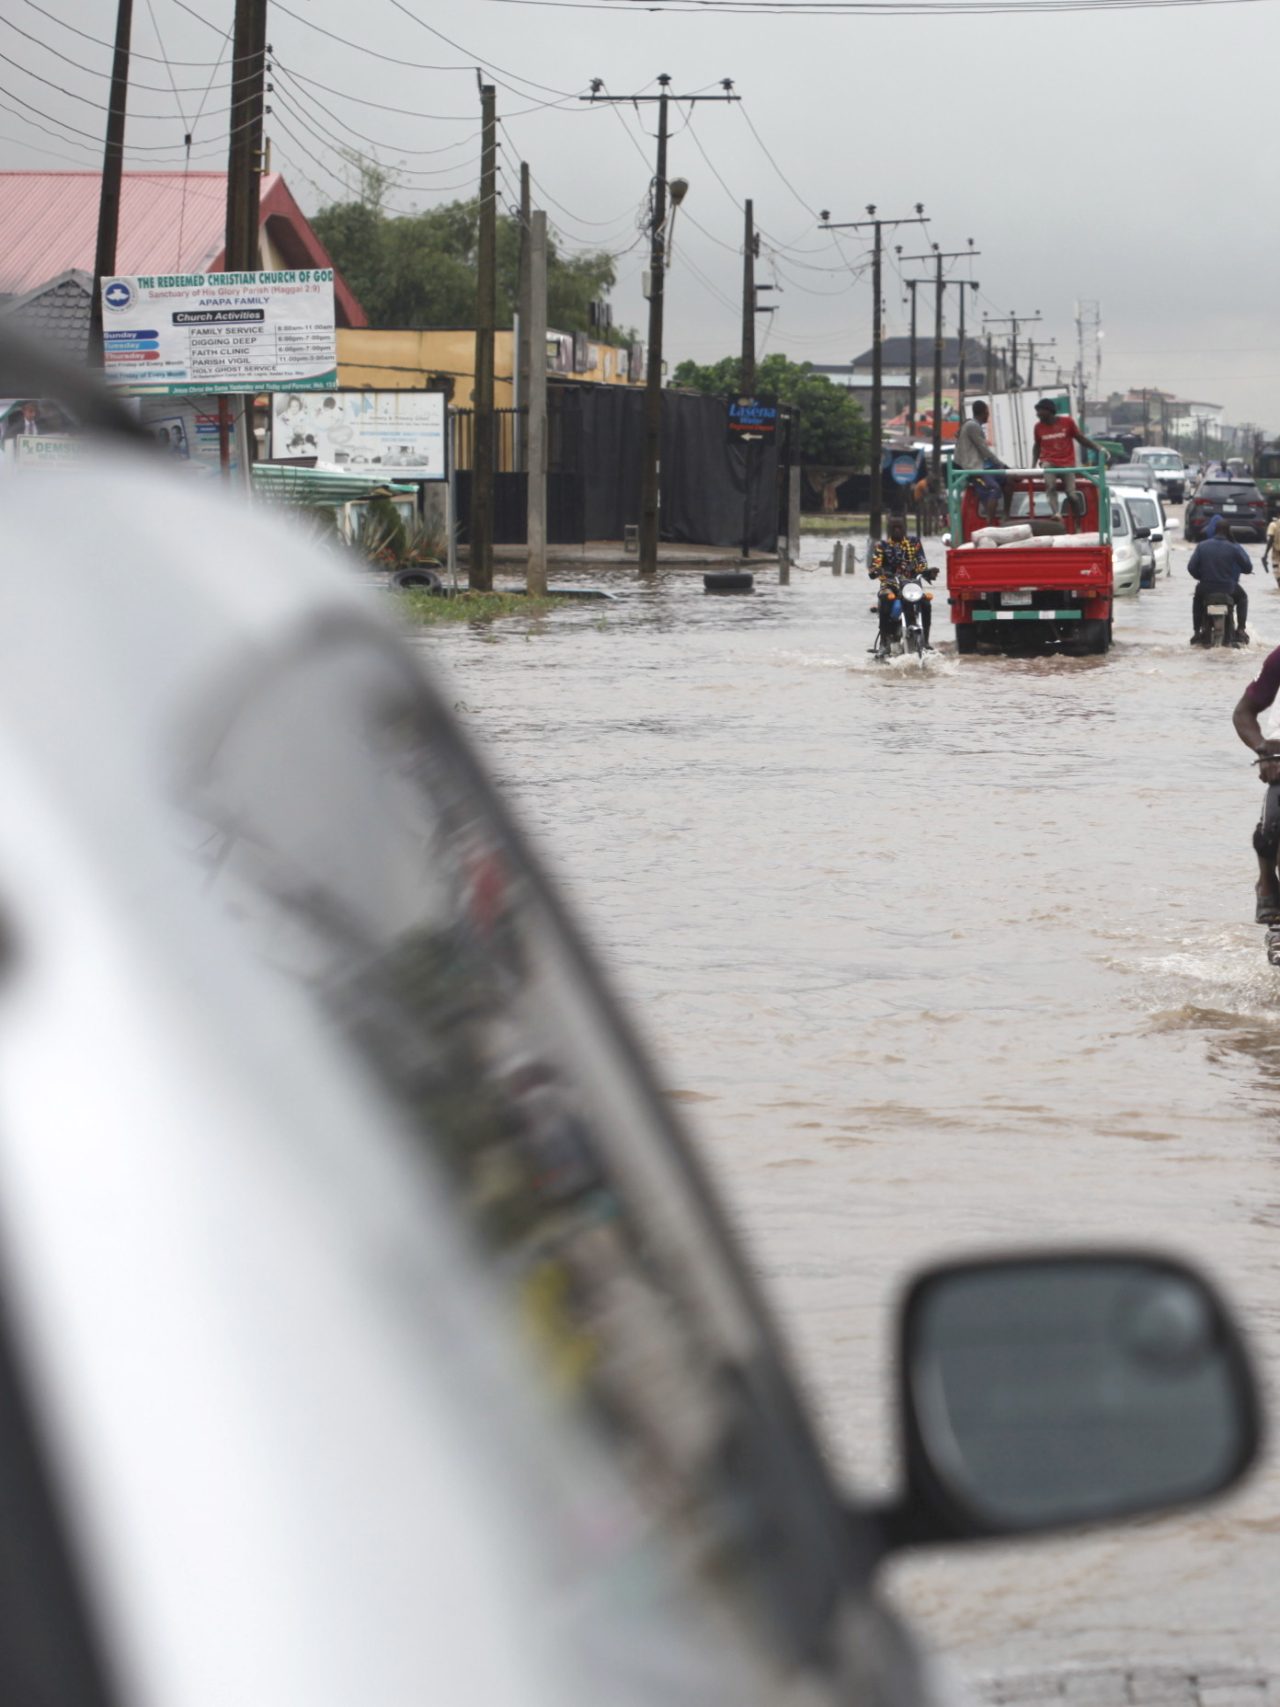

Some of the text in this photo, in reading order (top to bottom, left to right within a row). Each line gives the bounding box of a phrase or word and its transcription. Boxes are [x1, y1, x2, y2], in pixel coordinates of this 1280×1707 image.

[138, 270, 334, 289] THE REDEEMED CHRISTIAN CHURCH OF GOD
[148, 290, 189, 299] Sanctuary
[192, 288, 201, 297] of
[202, 288, 216, 297] His
[218, 287, 240, 298] Glory
[243, 285, 269, 295] Parish
[199, 296, 270, 307] APAPA FAMILY
[176, 311, 261, 322] Church Activities
[104, 332, 137, 340] Sunday
[191, 326, 264, 336] FAMILY SERVICE
[192, 337, 257, 346] DIGGING DEEP
[192, 349, 218, 357] FAITH
[192, 359, 225, 367] PARISH
